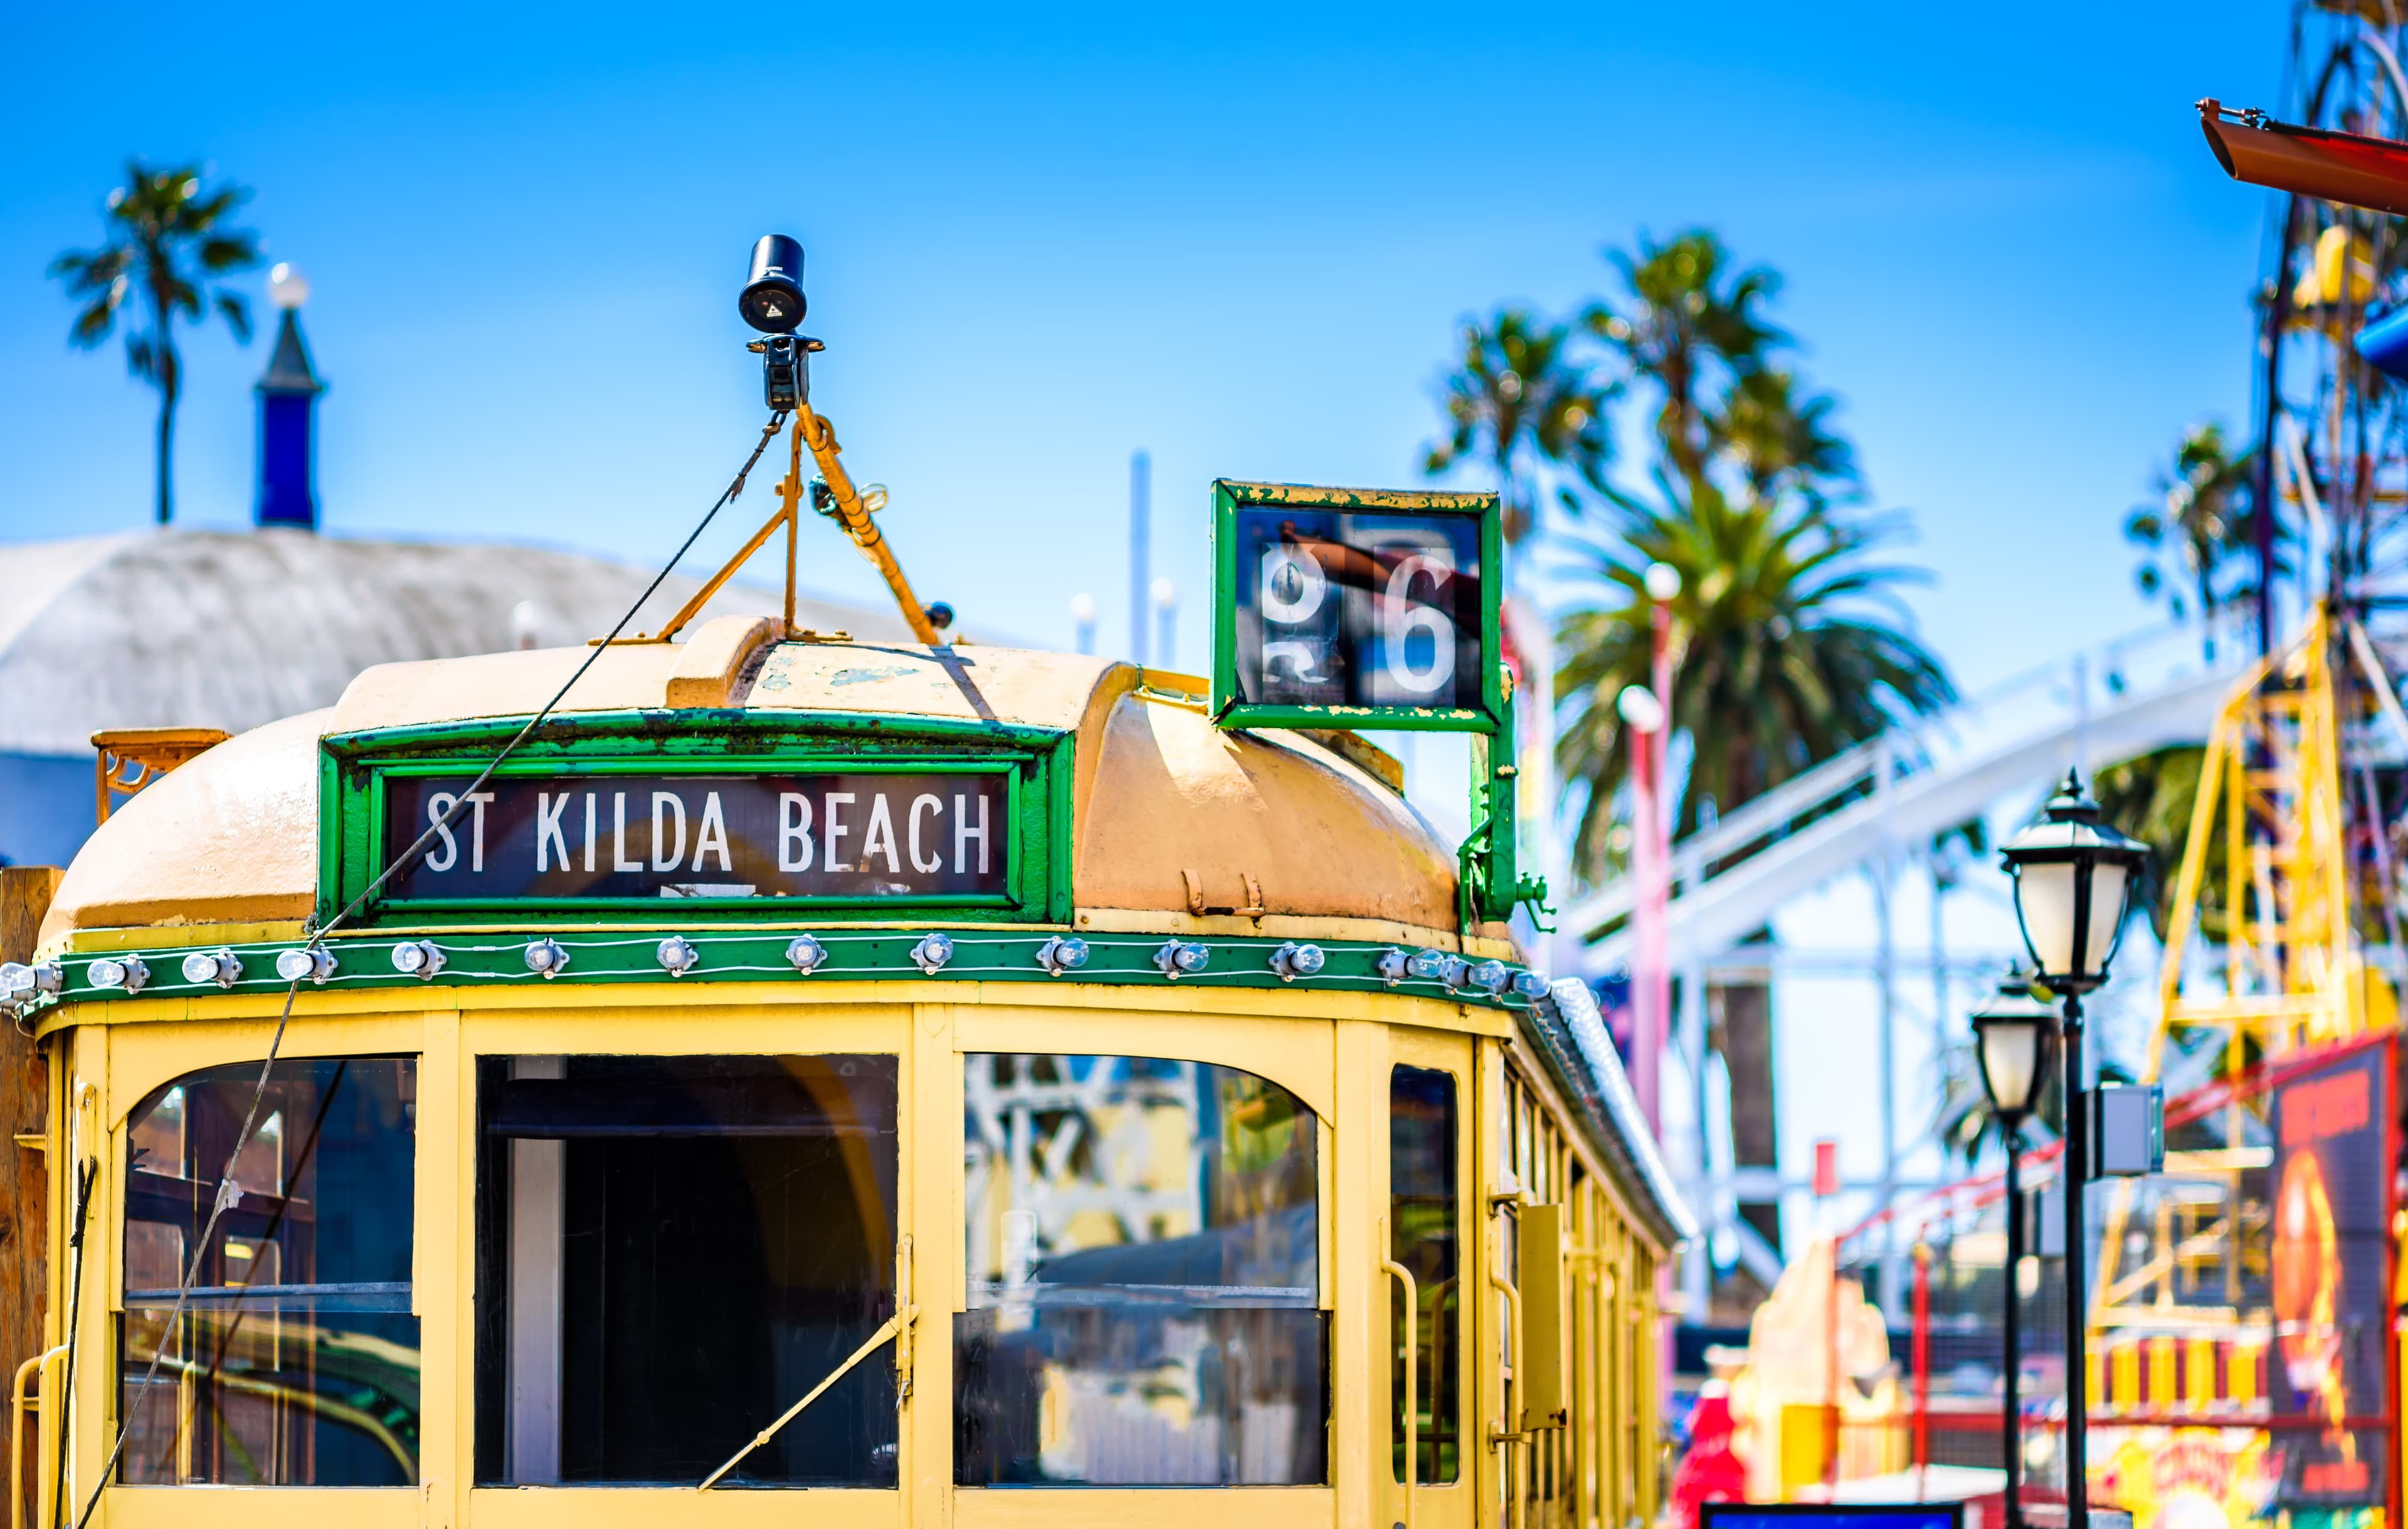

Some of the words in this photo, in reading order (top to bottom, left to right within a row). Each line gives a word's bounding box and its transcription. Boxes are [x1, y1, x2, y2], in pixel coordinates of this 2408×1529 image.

[426, 791, 494, 872] ST
[537, 791, 731, 872] KILDA
[779, 792, 989, 874] BEACH
